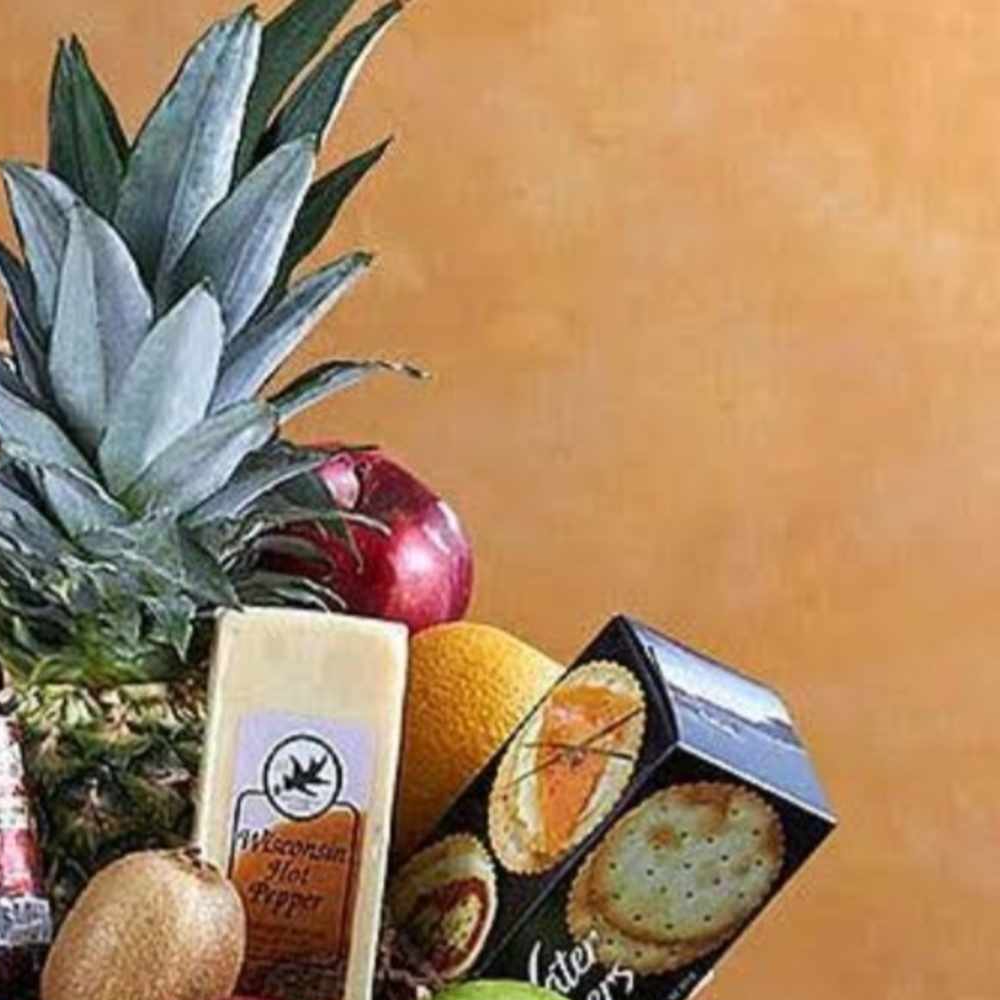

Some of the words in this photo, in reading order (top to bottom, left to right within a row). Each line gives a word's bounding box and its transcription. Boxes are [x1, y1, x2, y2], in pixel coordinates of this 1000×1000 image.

[236, 828, 347, 863] Wisconsin
[264, 859, 310, 886] Hot
[247, 881, 323, 918] Pepper
